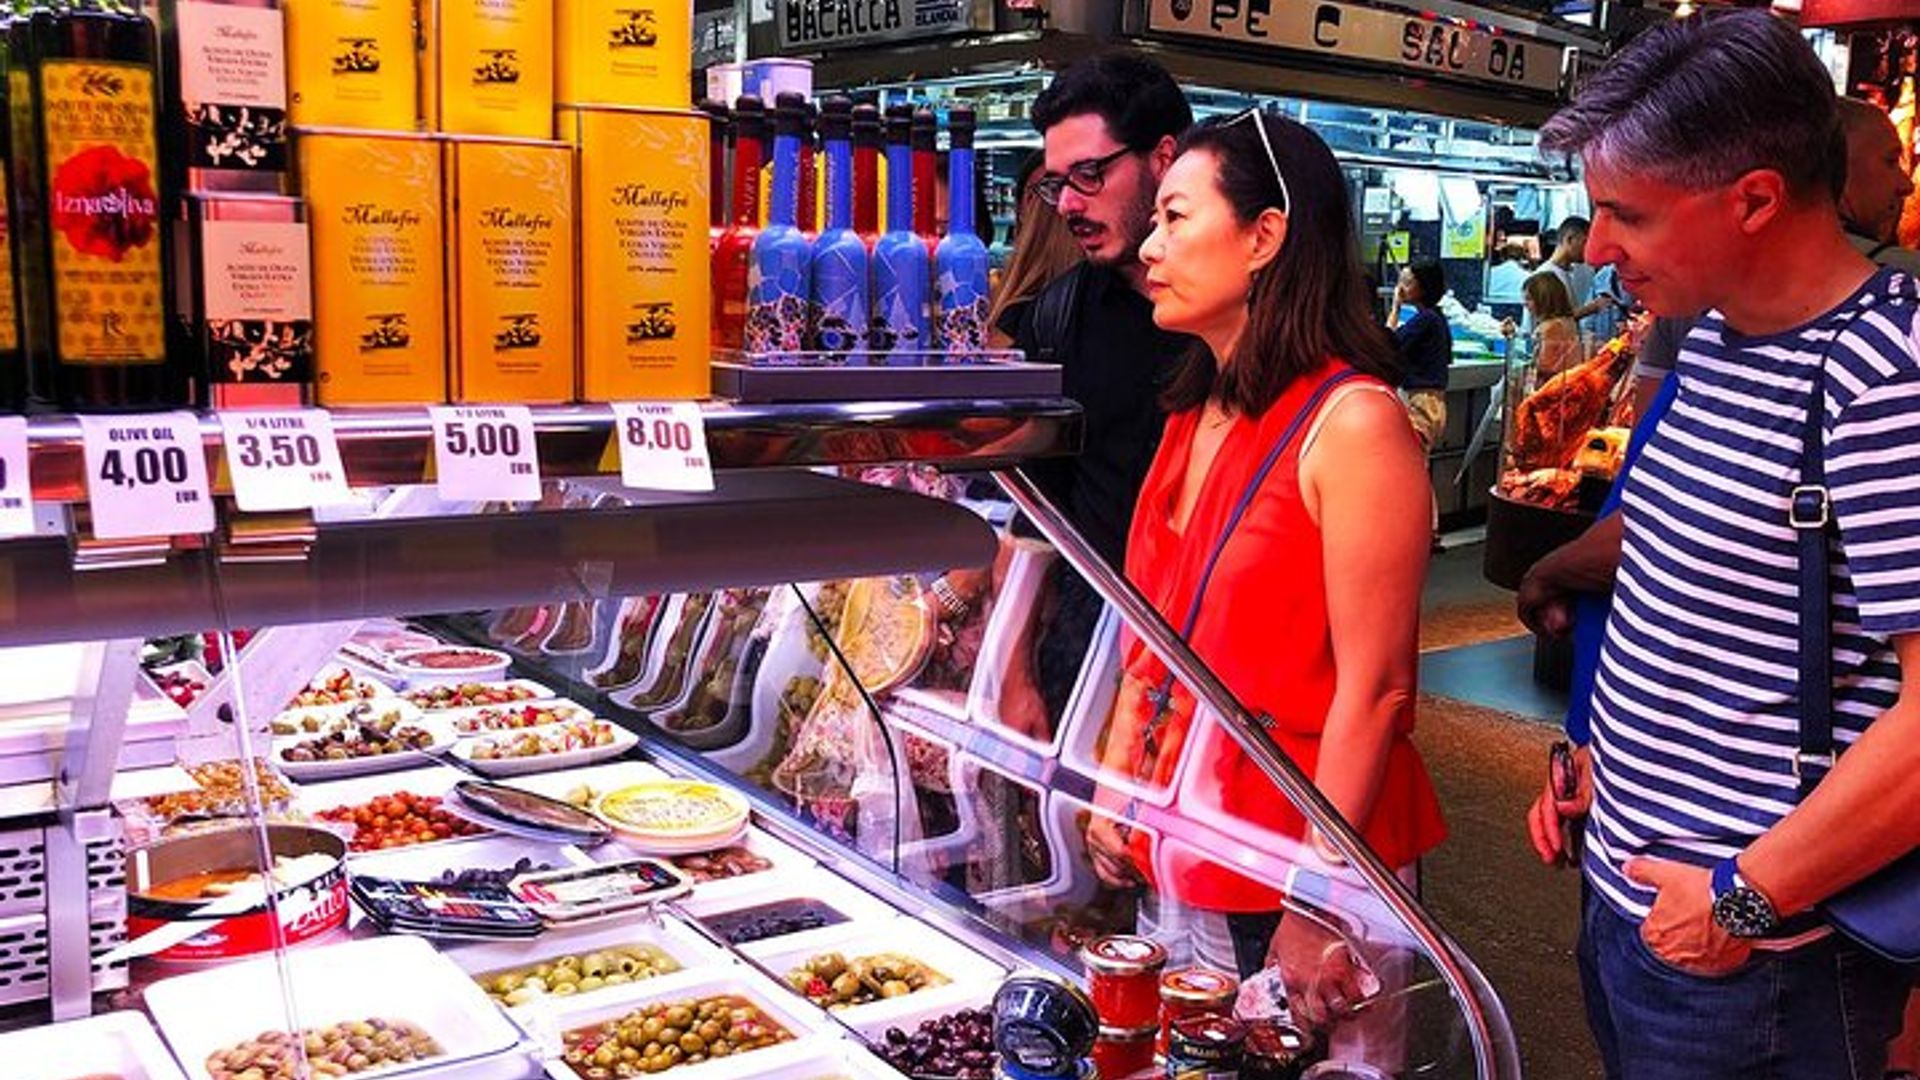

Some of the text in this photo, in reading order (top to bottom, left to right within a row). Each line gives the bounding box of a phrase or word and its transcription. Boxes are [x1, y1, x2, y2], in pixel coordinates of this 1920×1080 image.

[109, 427, 175, 441] OLIVE OIL
[445, 422, 520, 456] 5,00
[626, 417, 692, 451] 8,00
[100, 447, 187, 488] 4,00
[237, 434, 321, 469] 3,50
